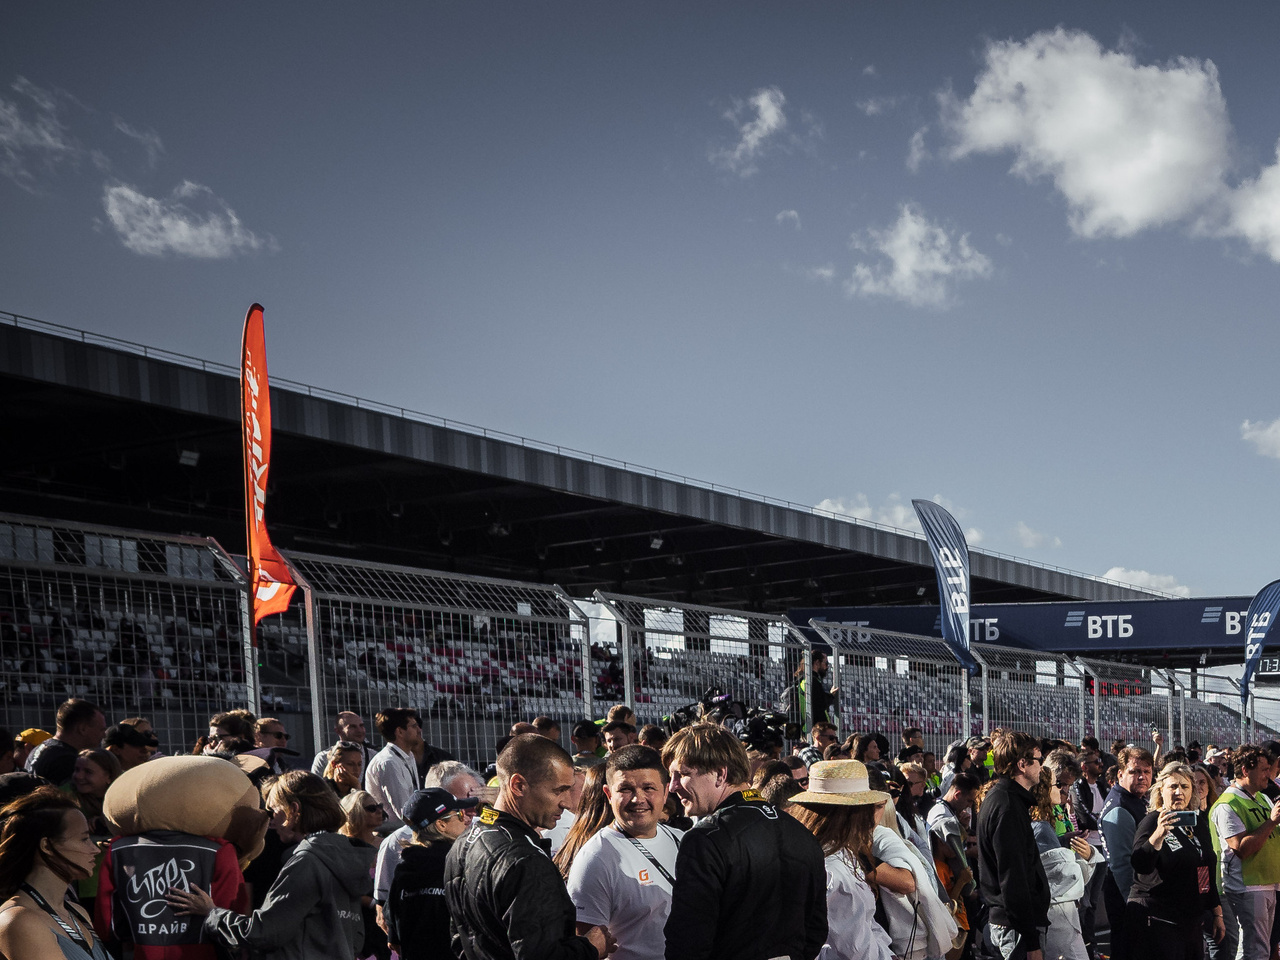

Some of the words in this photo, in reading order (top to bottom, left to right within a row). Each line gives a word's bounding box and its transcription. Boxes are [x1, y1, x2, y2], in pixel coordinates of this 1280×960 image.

[970, 618, 1000, 641] ТБ
[1087, 614, 1134, 639] ВТБ
[638, 869, 650, 882] G
[138, 921, 187, 935] ДРАЙВ
